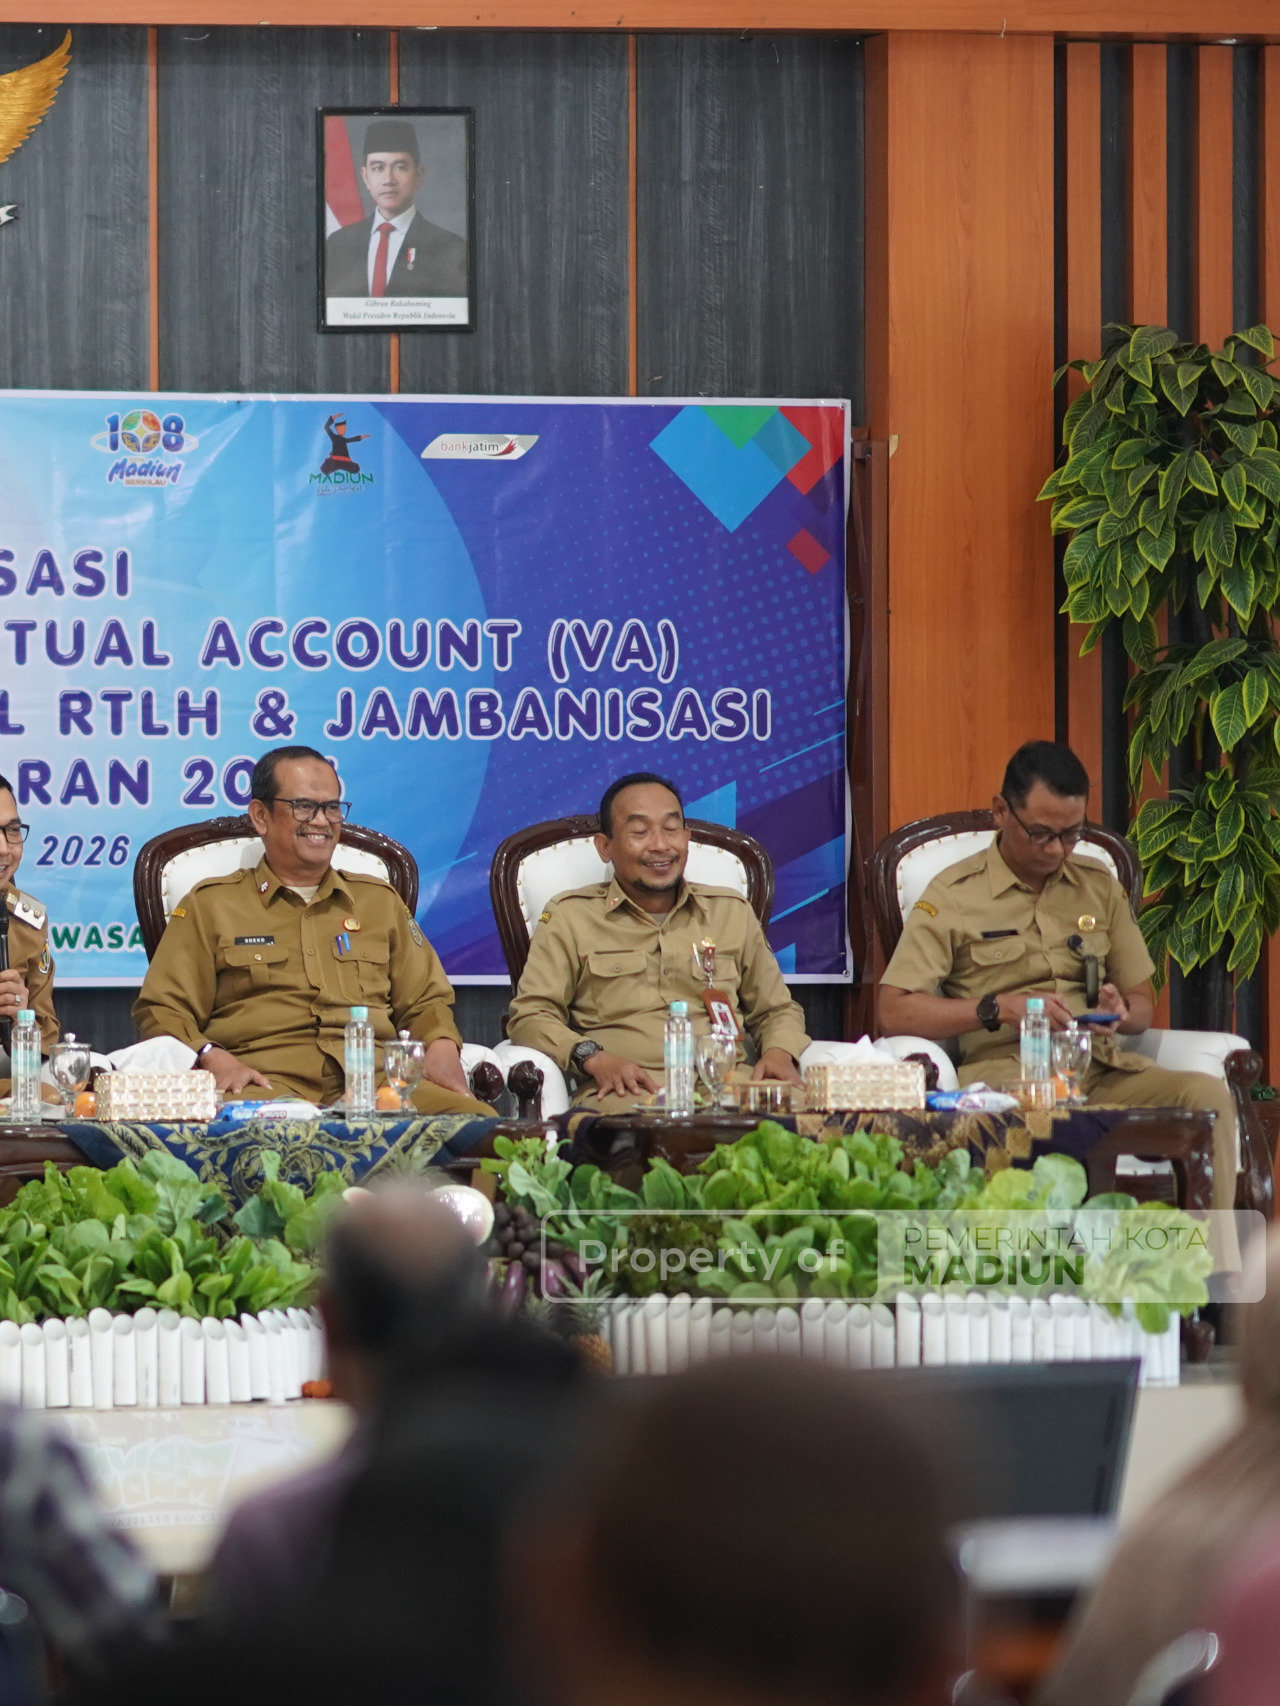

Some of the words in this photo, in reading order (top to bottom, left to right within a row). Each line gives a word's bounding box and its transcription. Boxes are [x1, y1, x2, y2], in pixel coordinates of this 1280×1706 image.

[441, 441, 499, 454] bankjatim
[108, 458, 182, 483] Madiun
[309, 472, 374, 484] MADIUN
[203, 619, 519, 670] ACCOUNT
[551, 621, 678, 681] (VA)
[59, 690, 218, 737] RTLH
[253, 690, 294, 737] &
[325, 689, 771, 740] JAMBANISASI
[36, 835, 130, 866] 2026
[51, 925, 144, 949] WASA
